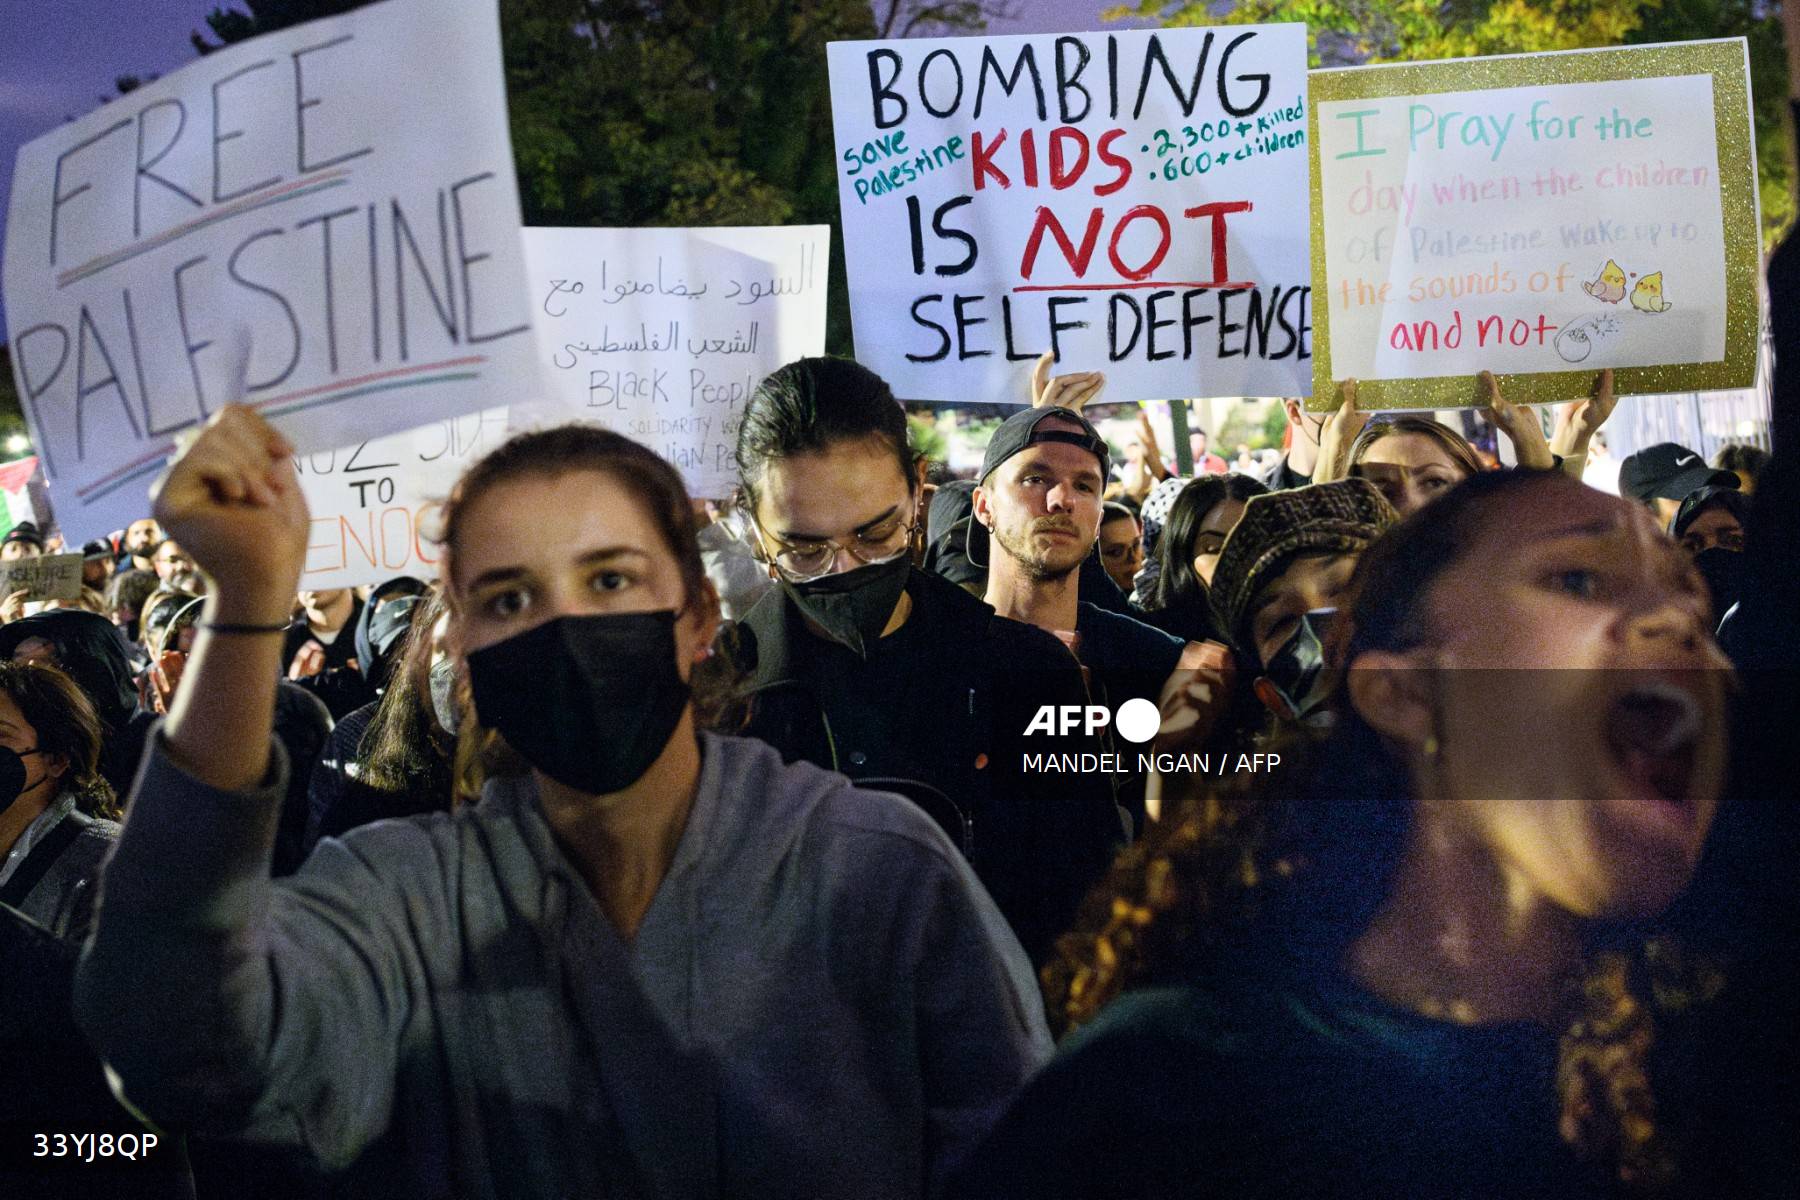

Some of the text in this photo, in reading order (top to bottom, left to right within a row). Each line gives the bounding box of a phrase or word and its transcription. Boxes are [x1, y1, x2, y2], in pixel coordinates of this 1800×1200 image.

[868, 32, 1271, 129] BOMBING
[50, 34, 374, 267] FREE
[1335, 100, 1654, 162] I Pray for the
[971, 127, 1133, 196] KIDS
[1348, 169, 1416, 227] day
[1431, 173, 1521, 205] when
[1531, 168, 1583, 197] the
[906, 194, 1253, 283] IS NOT
[1346, 225, 1390, 264] of
[1409, 226, 1544, 263] Palestine
[1634, 223, 1662, 248] up
[1671, 222, 1698, 241] to
[544, 279, 584, 317] مع
[1341, 261, 1575, 311] the sounds of
[15, 172, 532, 479] PALESTINE
[687, 321, 758, 358] الشعب
[905, 284, 1312, 364] SELF DEFENSE
[1390, 311, 1558, 351] and not
[349, 477, 395, 508] TO
